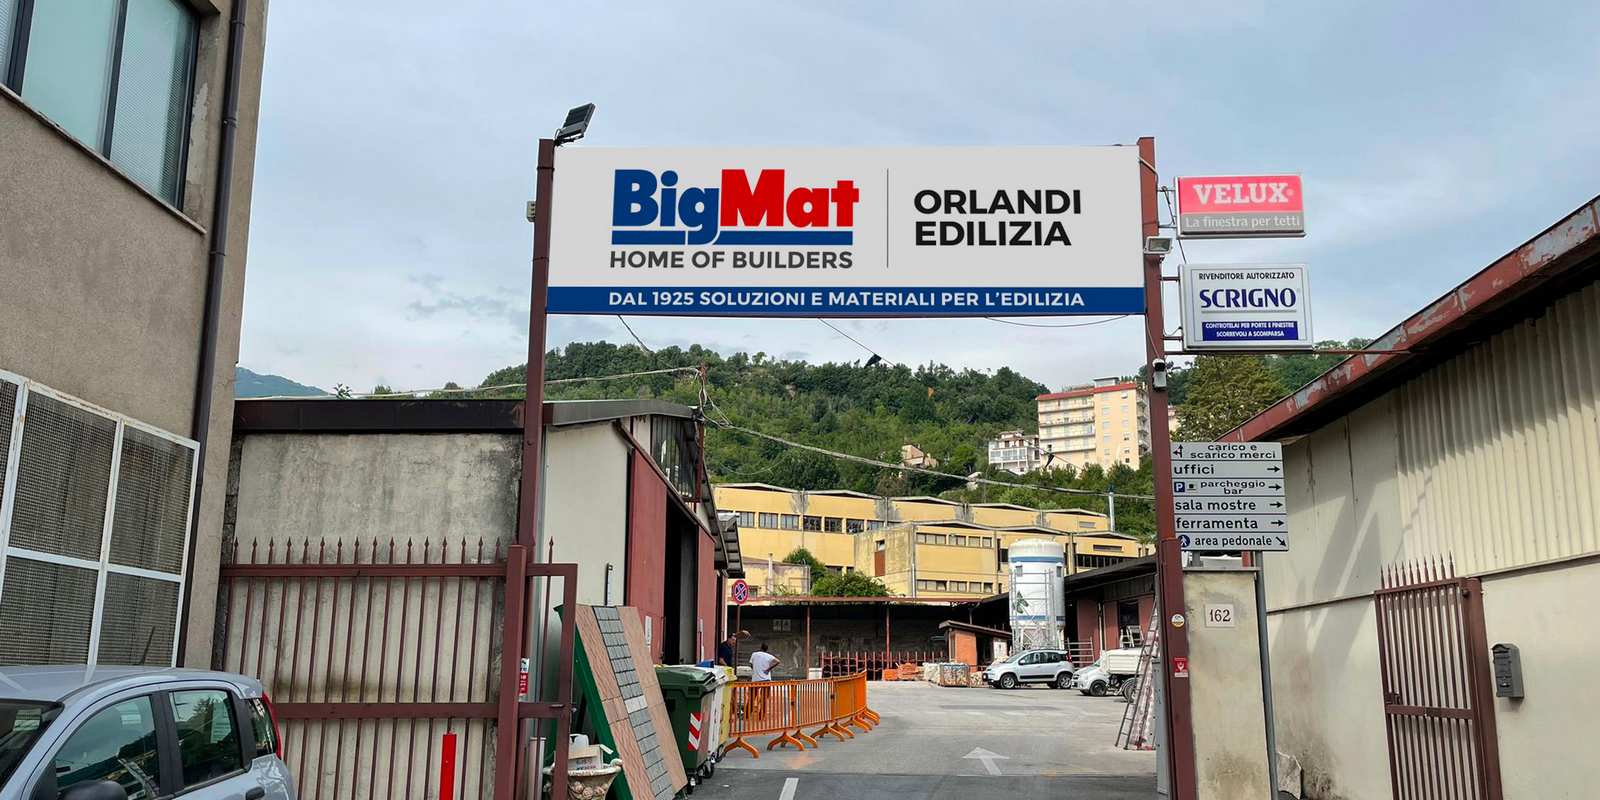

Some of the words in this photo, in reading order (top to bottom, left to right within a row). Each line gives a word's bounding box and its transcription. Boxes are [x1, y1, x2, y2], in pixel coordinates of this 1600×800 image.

[612, 169, 860, 245] BigMat
[913, 189, 1081, 215] ORLANDI
[1185, 217, 1200, 228] La
[1203, 215, 1248, 227] finestra
[1251, 216, 1273, 229] per
[1275, 215, 1299, 226] tetti
[915, 221, 1072, 246] EDILIZIA
[610, 251, 685, 269] HOME
[691, 251, 725, 269] OF
[732, 251, 853, 269] BUILDERS
[1246, 272, 1295, 280] AUTORIZZATO
[609, 292, 647, 306] DAL
[652, 291, 694, 306] 1925
[700, 291, 805, 306] SOLUZIONI
[811, 292, 823, 306] E
[828, 292, 935, 306] MATERIALI
[941, 292, 979, 306] PER
[985, 292, 1085, 306] L'EDILIZIA
[1200, 287, 1297, 308] SCRIGNO
[1190, 450, 1236, 459] scarico
[1239, 450, 1276, 459] merci
[1173, 464, 1215, 475] uffici
[1176, 483, 1184, 491] P
[1200, 480, 1266, 489] parcheggio
[1223, 487, 1244, 495] bar
[1175, 499, 1203, 510] sala
[1207, 500, 1257, 511] mostre
[1176, 517, 1258, 529] ferramenta
[1194, 537, 1219, 546] area
[1222, 535, 1272, 547] pedonale
[1209, 608, 1232, 622] 162
